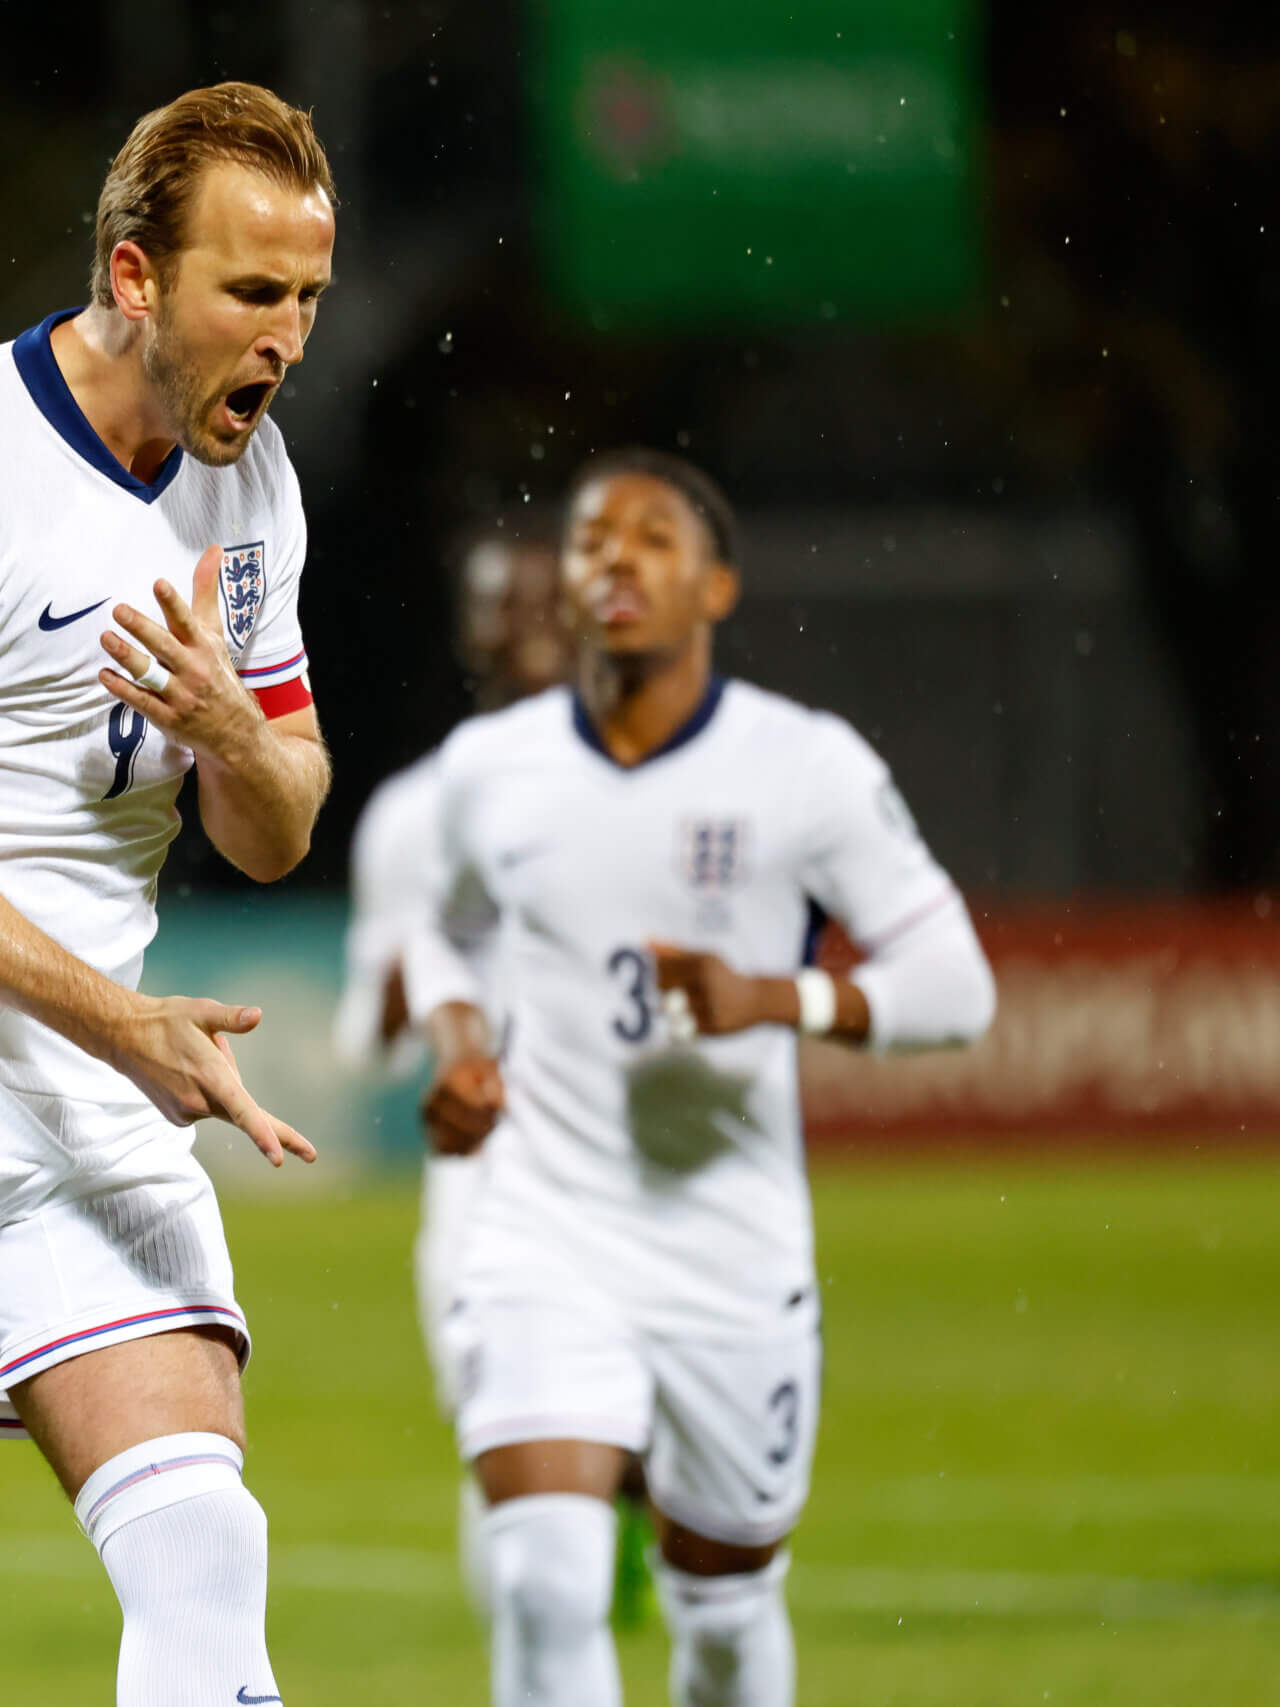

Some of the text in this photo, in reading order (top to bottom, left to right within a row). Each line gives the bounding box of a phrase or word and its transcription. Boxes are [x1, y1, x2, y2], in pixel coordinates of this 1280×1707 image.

[101, 701, 148, 801] 9
[607, 947, 652, 1043] 3
[768, 1381, 800, 1464] 3
